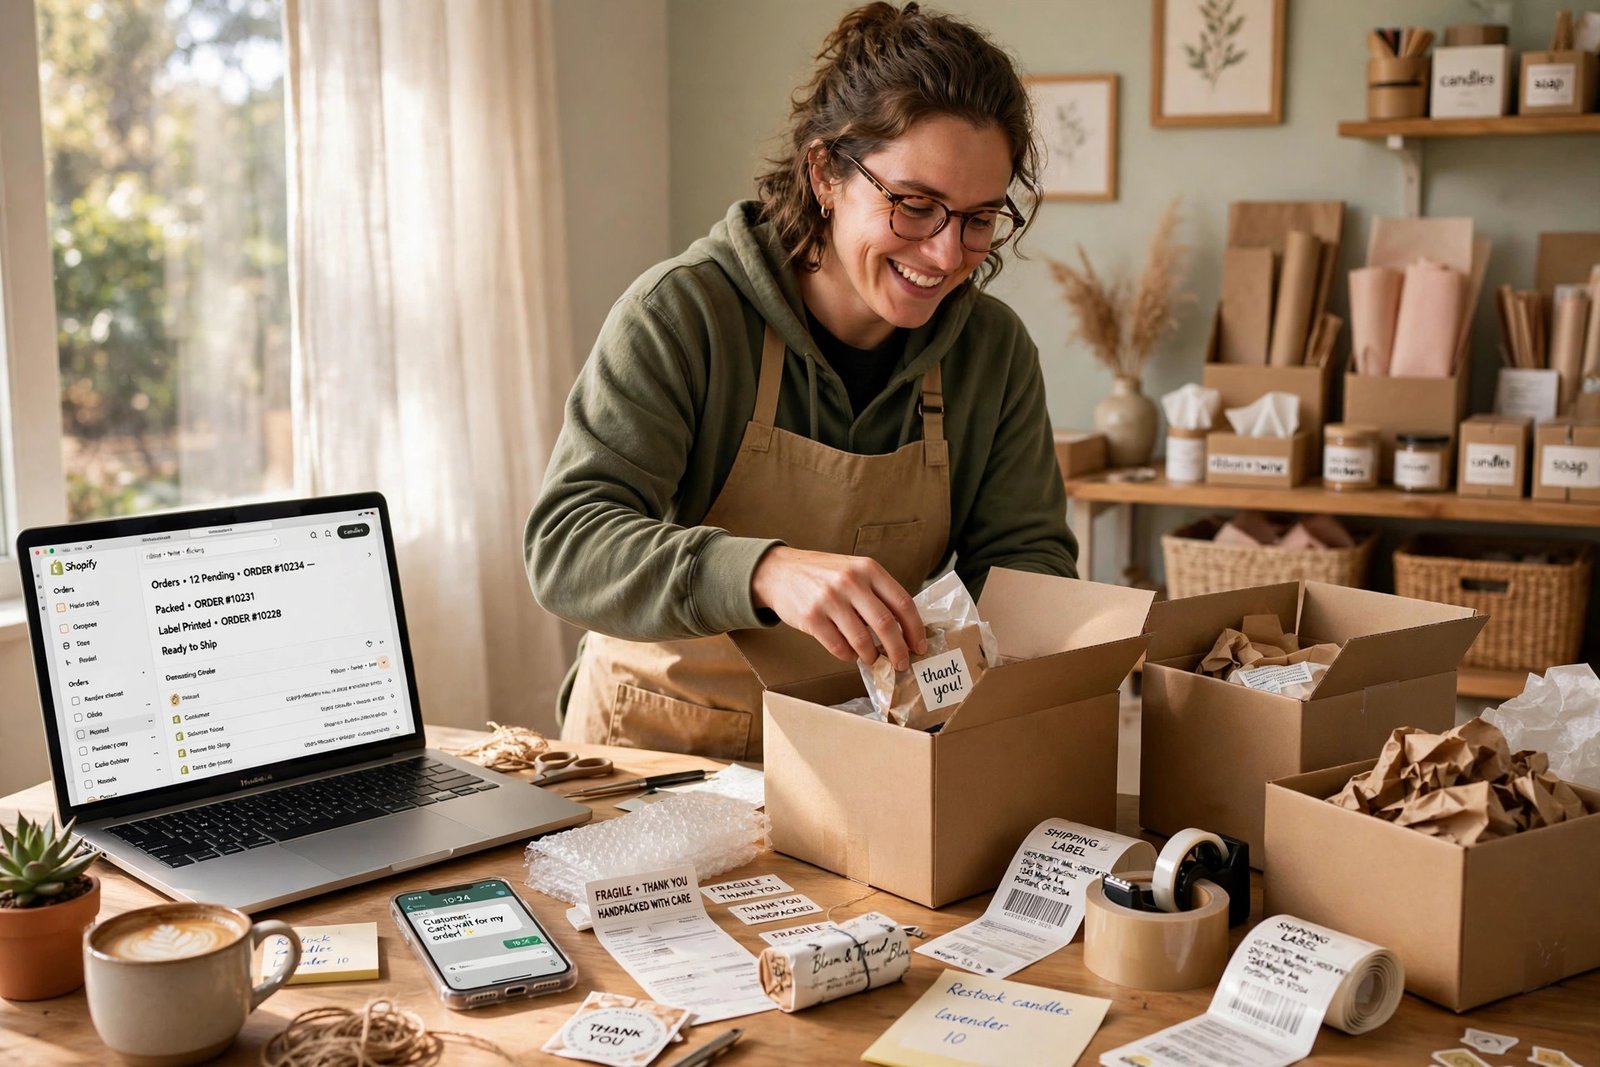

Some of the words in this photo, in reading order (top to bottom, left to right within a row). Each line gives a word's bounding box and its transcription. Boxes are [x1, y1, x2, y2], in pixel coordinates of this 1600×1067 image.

[1440, 69, 1495, 88] candles
[1553, 459, 1589, 478] soap
[65, 559, 97, 572] Shopify
[151, 579, 180, 589] Orders
[189, 574, 200, 584] 12
[201, 571, 235, 583] Pending
[243, 565, 272, 577] ORDER
[274, 561, 305, 573] #10234
[53, 586, 75, 594] Orders
[155, 602, 185, 614] Packed
[194, 596, 225, 609] ORDER
[225, 592, 255, 603] #10231
[158, 623, 181, 635] Label
[182, 619, 212, 632] Printed
[221, 613, 251, 626] ORDER
[251, 609, 282, 621] #10228
[161, 644, 187, 656] Ready
[189, 643, 199, 652] to
[200, 640, 218, 650] Ship
[921, 659, 962, 684] thank
[68, 679, 89, 687] Orders
[933, 675, 963, 703] you!
[1044, 828, 1100, 848] SHIPPING
[1051, 841, 1086, 857] LABEL
[595, 886, 633, 901] FRAGILE
[642, 880, 670, 893] THANK
[670, 876, 688, 887] YOU
[719, 889, 756, 900] THANK
[757, 885, 781, 894] YOU
[597, 901, 650, 919] HANDPACKED
[650, 898, 670, 910] WITH
[671, 893, 692, 906] CARE
[740, 902, 778, 913] THANK
[778, 897, 802, 906] YOU
[423, 913, 471, 926] Customer:
[427, 923, 451, 934] Can't
[453, 920, 474, 929] wait
[475, 917, 488, 925] for
[490, 915, 504, 923] my
[433, 930, 462, 941] order!
[772, 925, 824, 939] FRAGILE
[946, 982, 1006, 1003] Restock
[1012, 999, 1073, 1016] candles
[589, 1023, 645, 1038] THANK
[943, 1031, 967, 1045] 10
[588, 1034, 625, 1046] YOU
